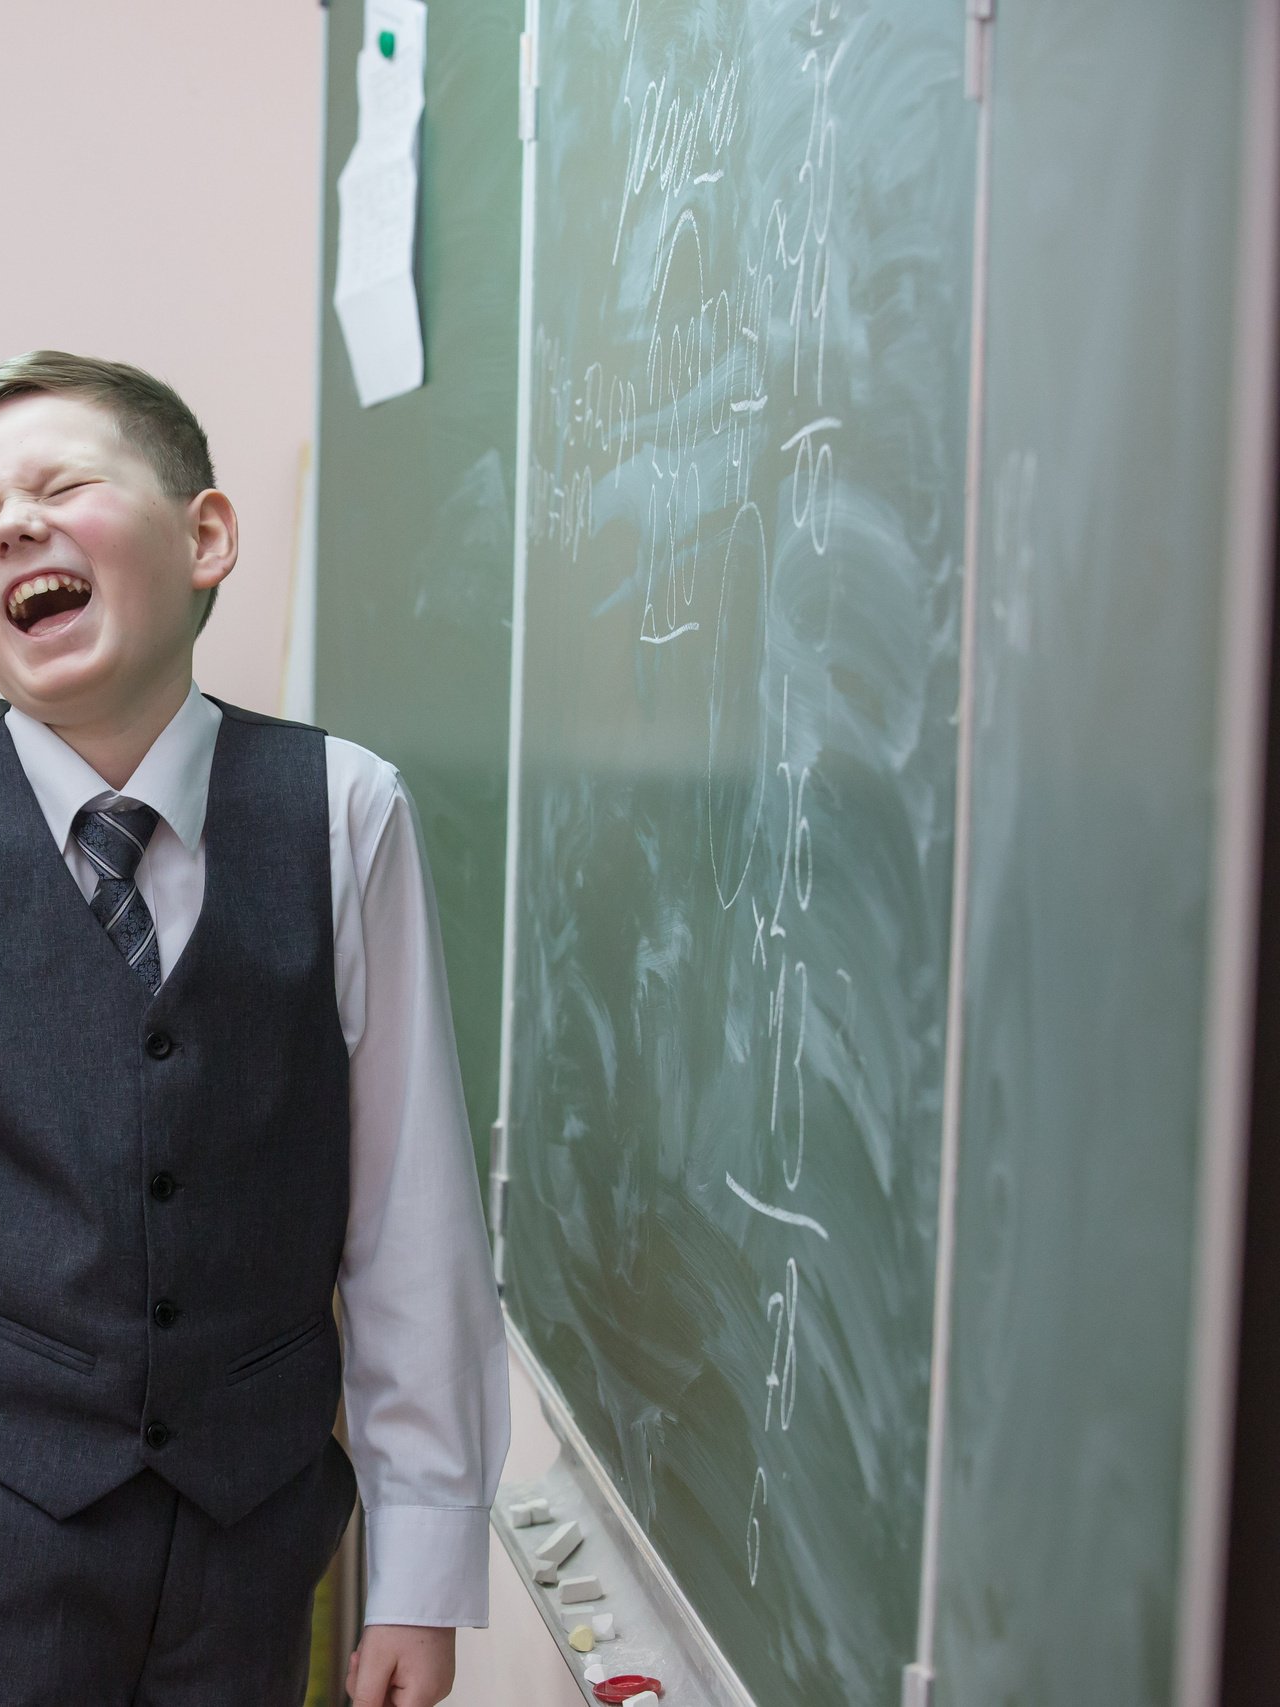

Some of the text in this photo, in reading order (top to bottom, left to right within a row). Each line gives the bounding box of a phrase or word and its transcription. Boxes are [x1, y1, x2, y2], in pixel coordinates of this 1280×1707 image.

[770, 761, 813, 937] 26
[764, 1257, 798, 1431] 78
[746, 1466, 768, 1588] 6
